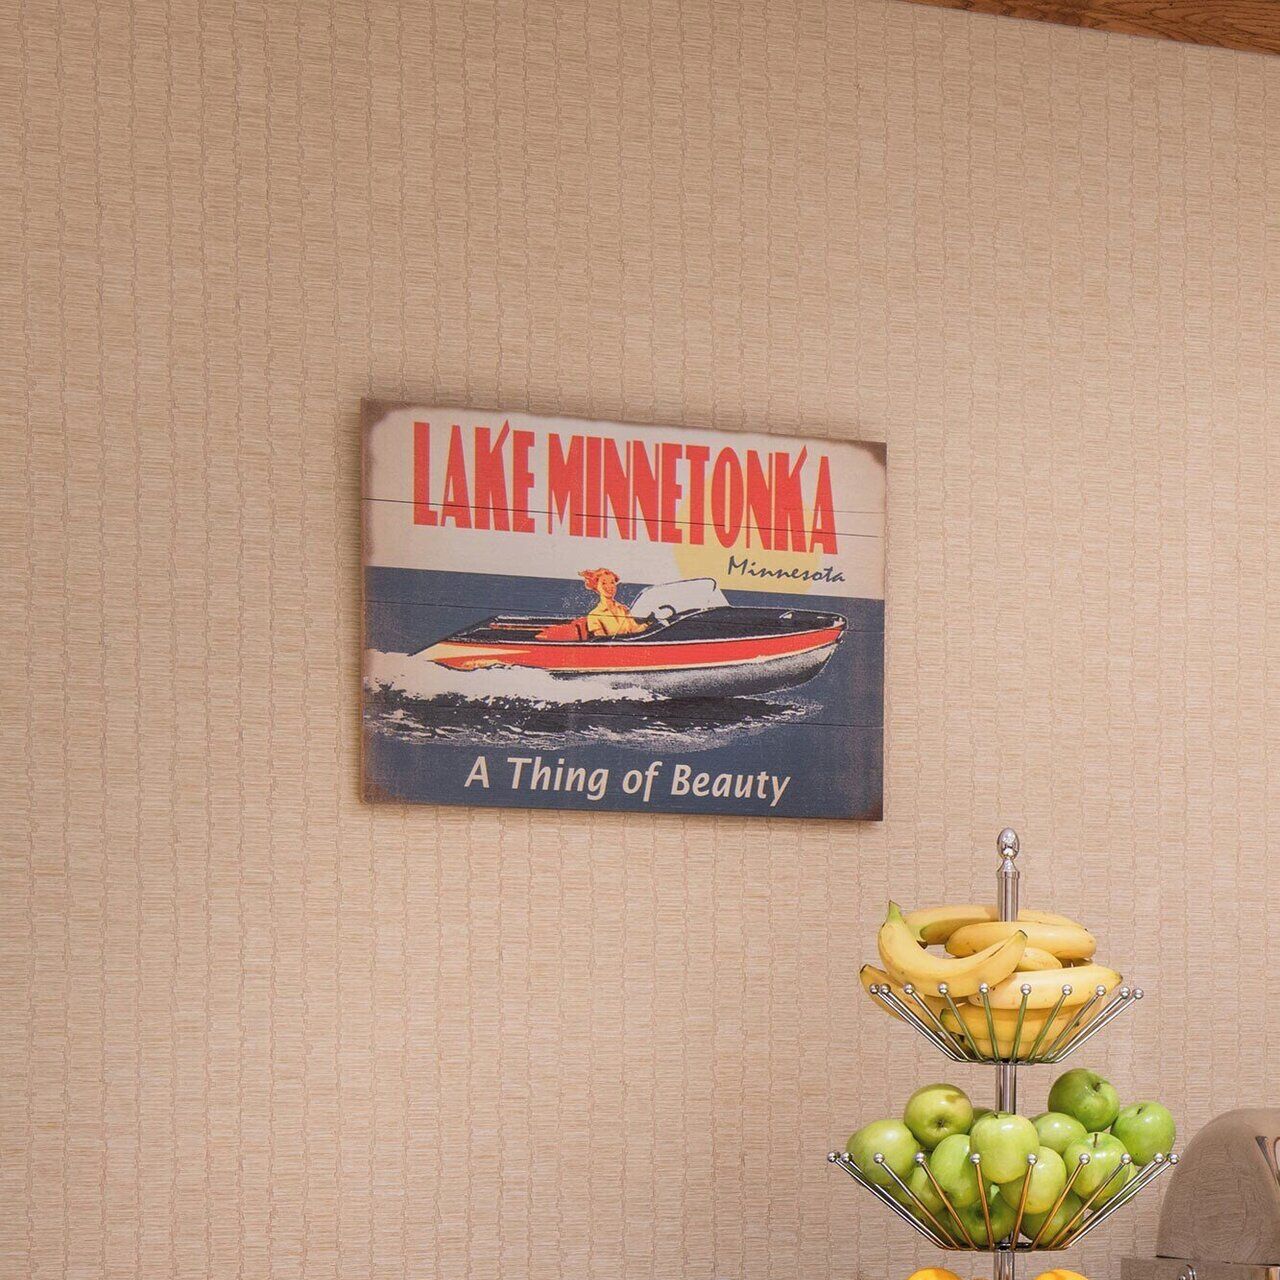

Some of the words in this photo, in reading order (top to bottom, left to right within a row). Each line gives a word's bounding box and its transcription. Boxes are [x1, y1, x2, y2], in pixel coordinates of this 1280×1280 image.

[412, 418, 535, 533] LAKE
[547, 432, 838, 555] MINNETONKA
[727, 556, 845, 583] Minnesota
[465, 756, 490, 788] A
[507, 757, 609, 801] Thing
[622, 761, 663, 802] of
[671, 764, 791, 806] Beauty
